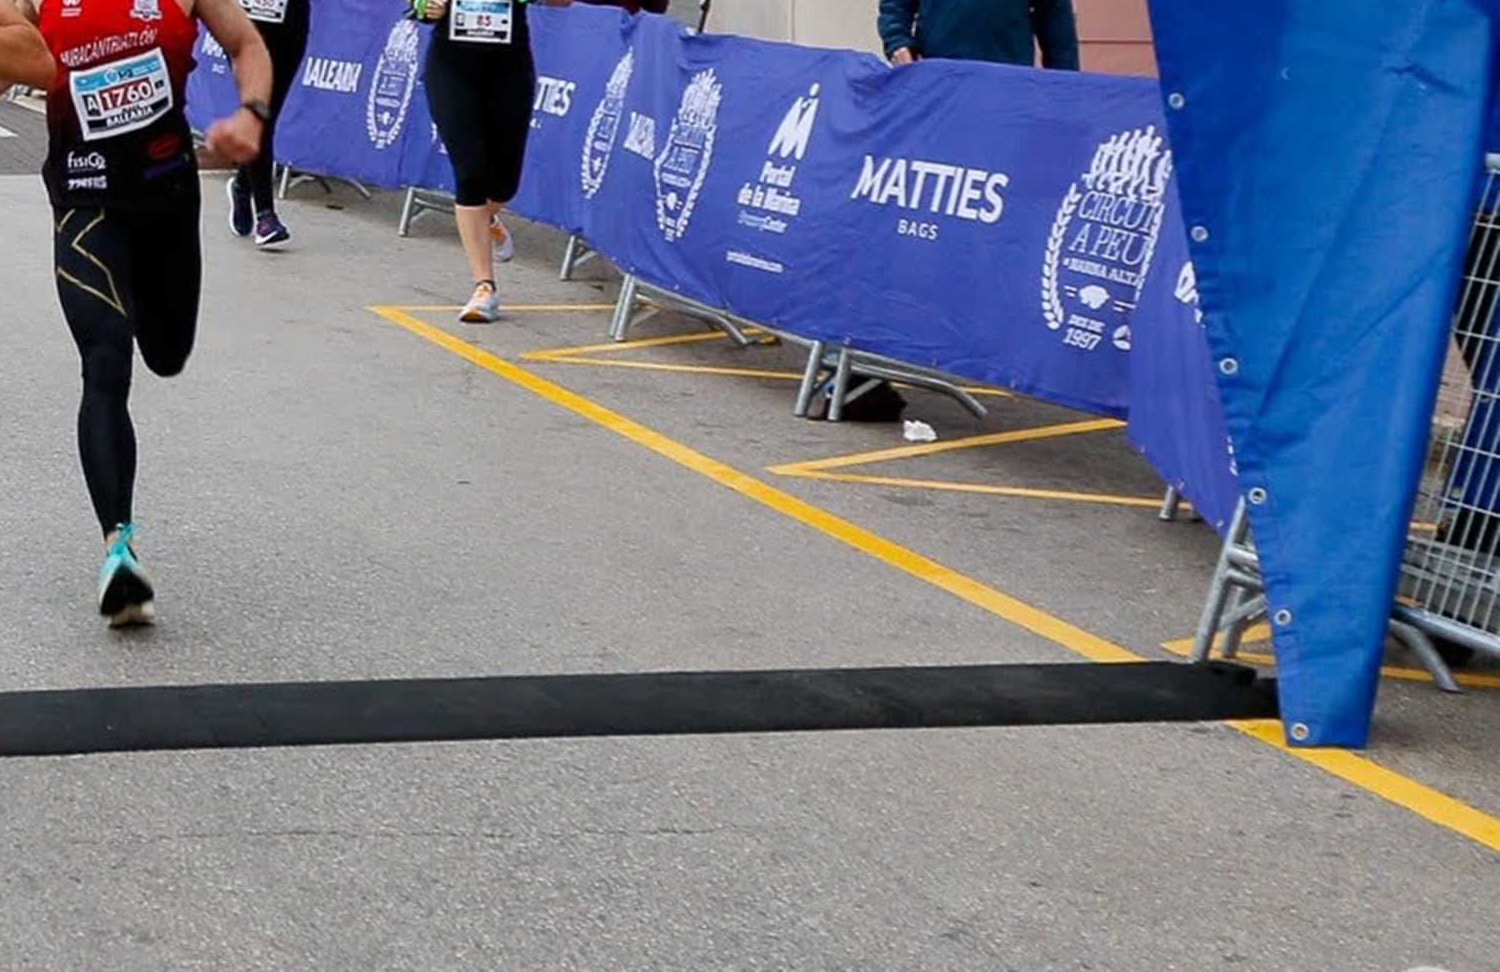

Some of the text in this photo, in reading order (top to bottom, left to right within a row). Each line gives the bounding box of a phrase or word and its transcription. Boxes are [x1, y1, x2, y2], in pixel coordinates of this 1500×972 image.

[86, 96, 98, 112] A
[101, 81, 153, 110] 1760
[850, 155, 1009, 224] MATTIES
[897, 218, 939, 241] BAGS
[1068, 223, 1151, 266] A PEU
[1063, 328, 1102, 352] 1997
